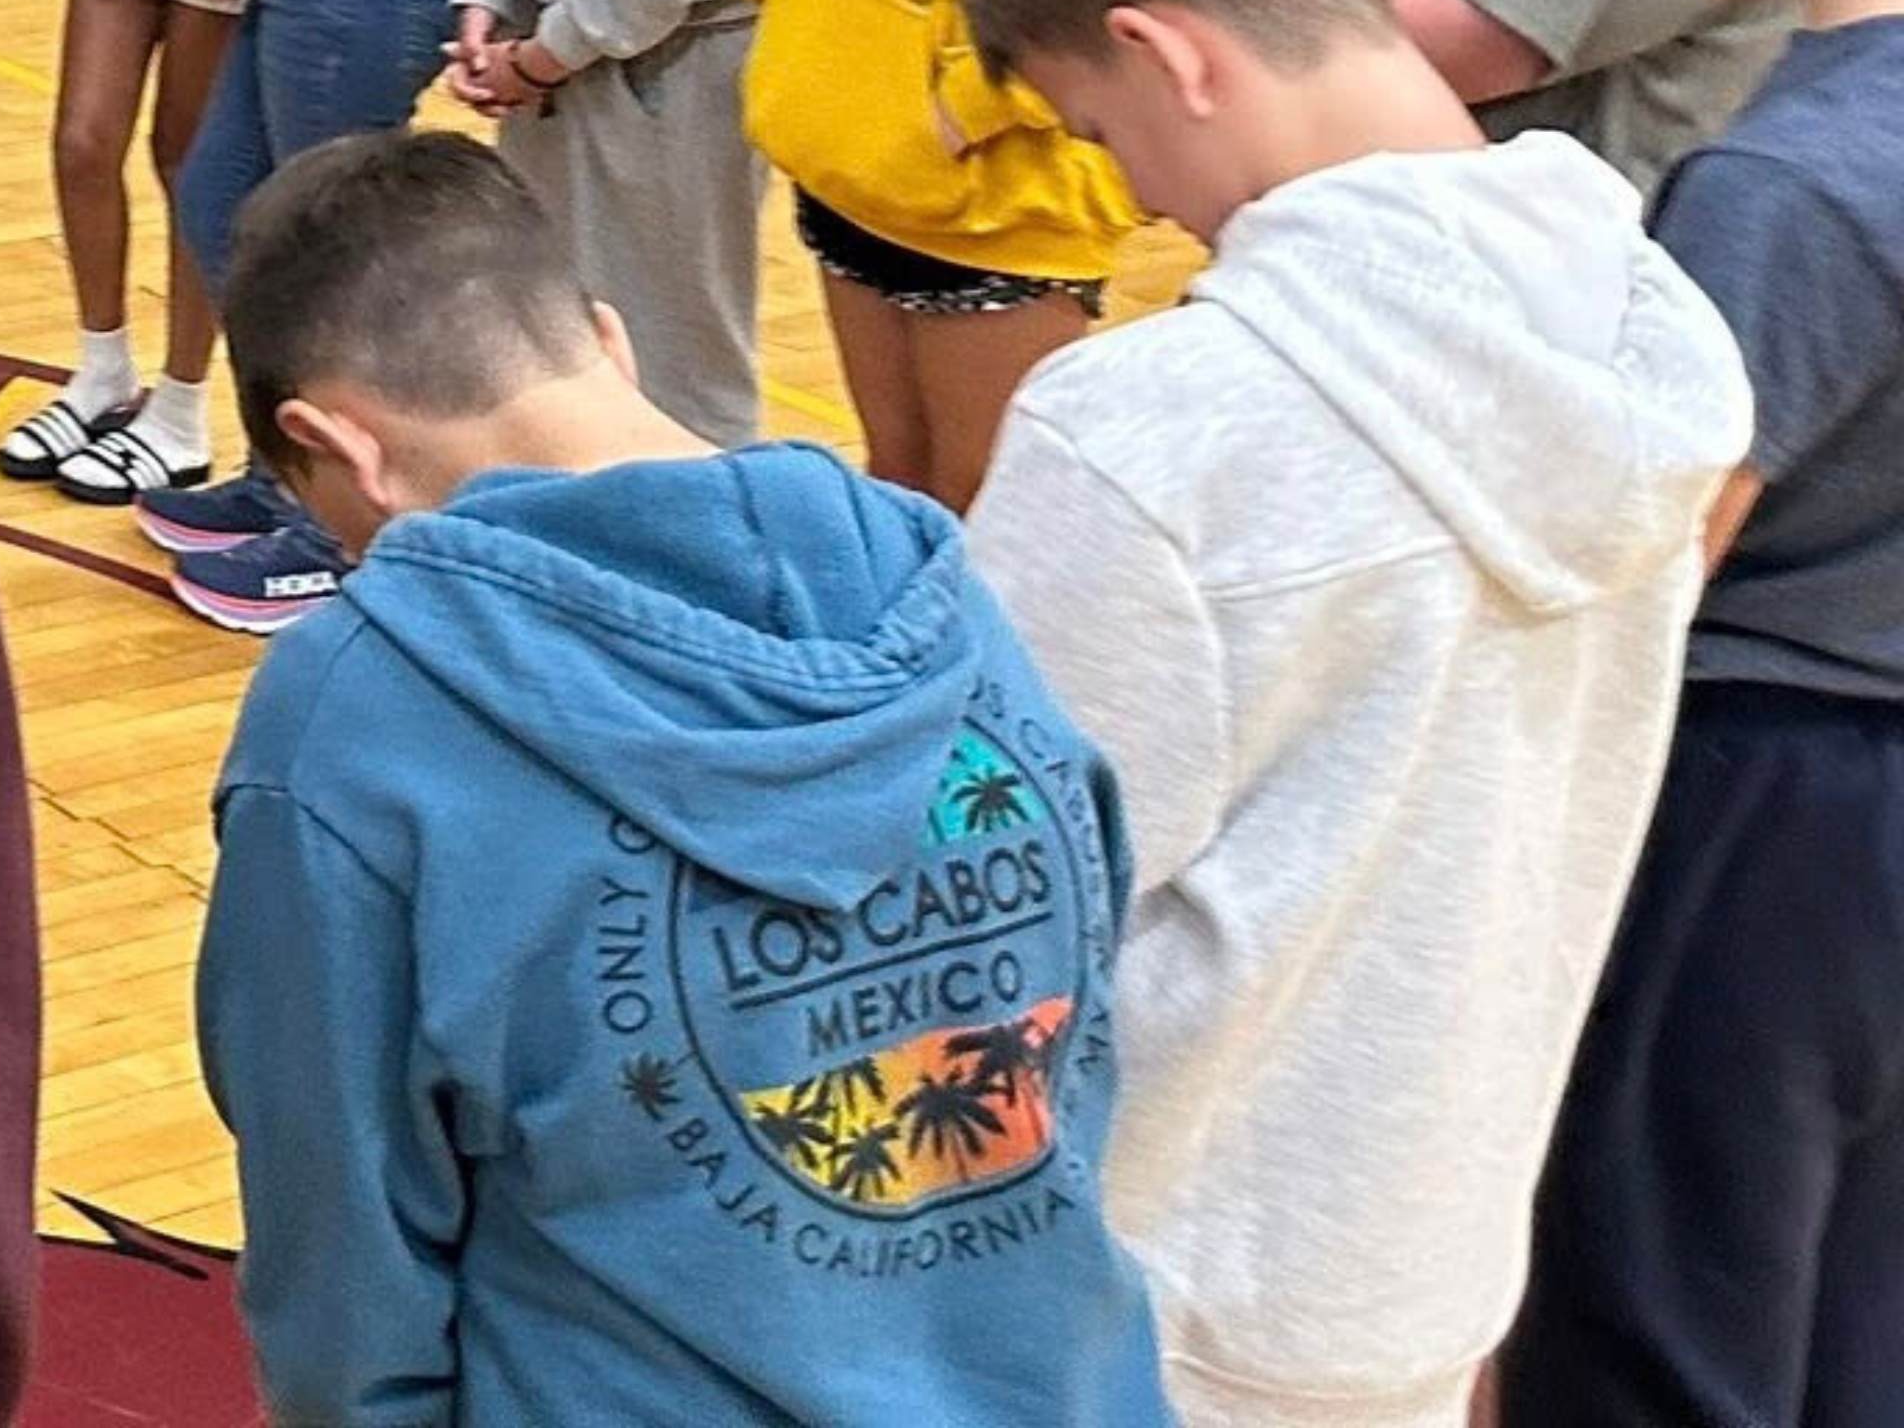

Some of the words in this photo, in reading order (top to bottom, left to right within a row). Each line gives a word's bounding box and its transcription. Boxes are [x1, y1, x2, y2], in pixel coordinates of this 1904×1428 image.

[597, 876, 653, 1034] ONLY
[710, 907, 845, 992] LOS
[856, 839, 1053, 946] CABOS
[804, 948, 1024, 1058] MEXICO
[666, 1116, 781, 1242] BAJA
[791, 1185, 1077, 1279] CALIFORNIA
